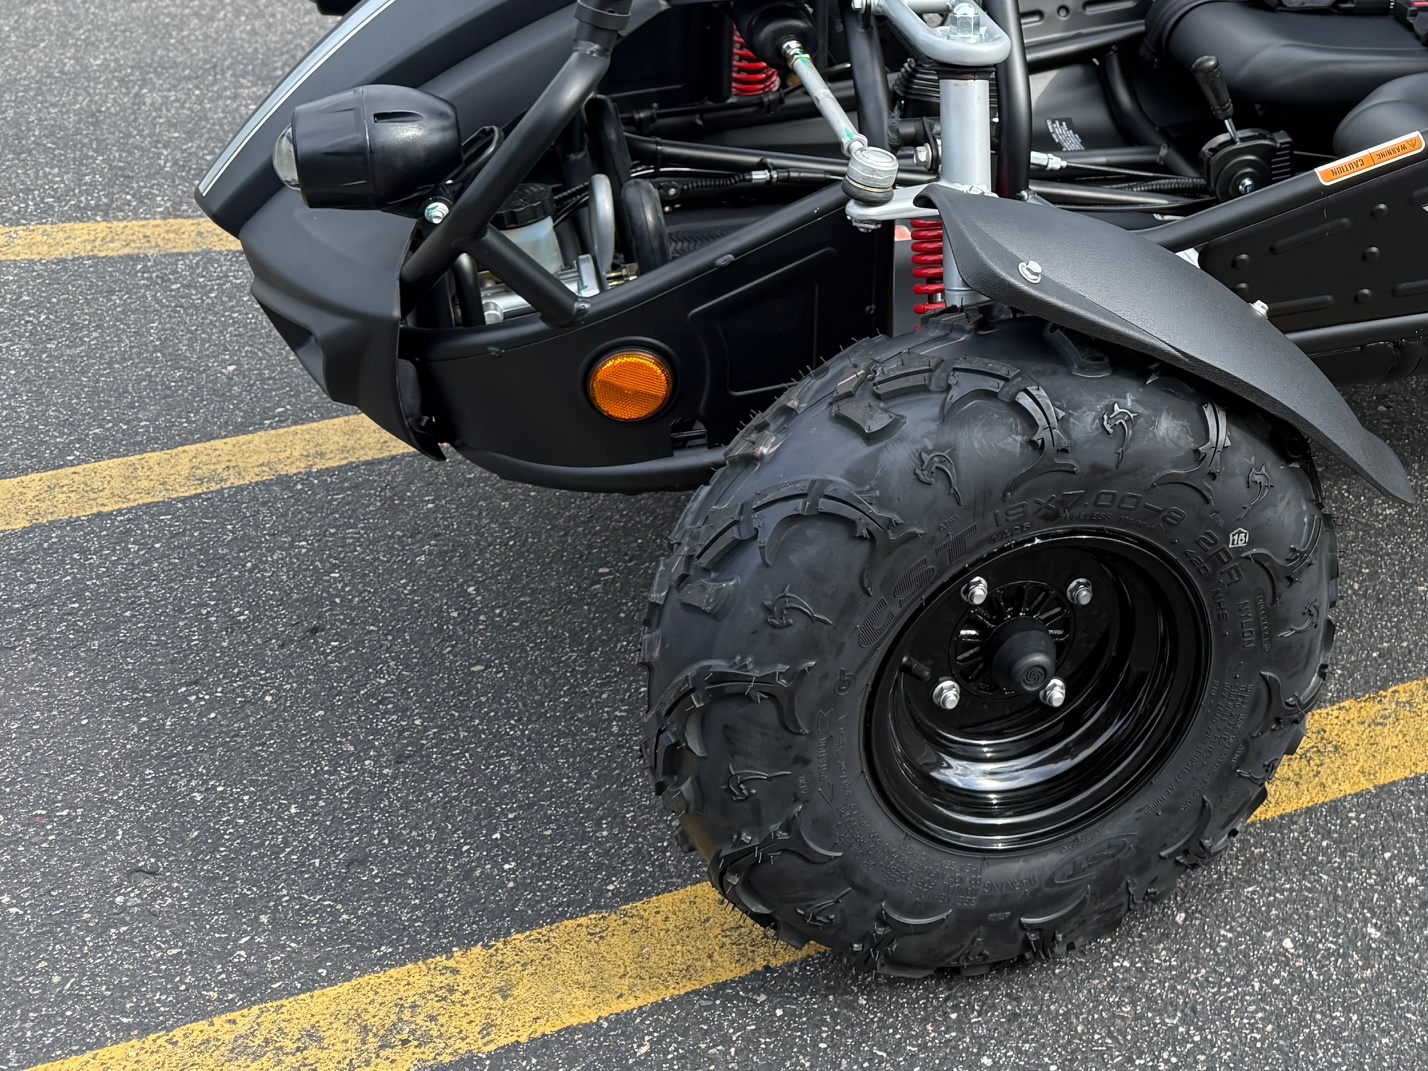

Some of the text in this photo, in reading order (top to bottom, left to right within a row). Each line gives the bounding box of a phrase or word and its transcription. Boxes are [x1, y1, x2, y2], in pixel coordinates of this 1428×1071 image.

[1377, 143, 1408, 160] WARNING
[1331, 158, 1365, 177] CAUTION
[1237, 600, 1256, 648] NYLON
